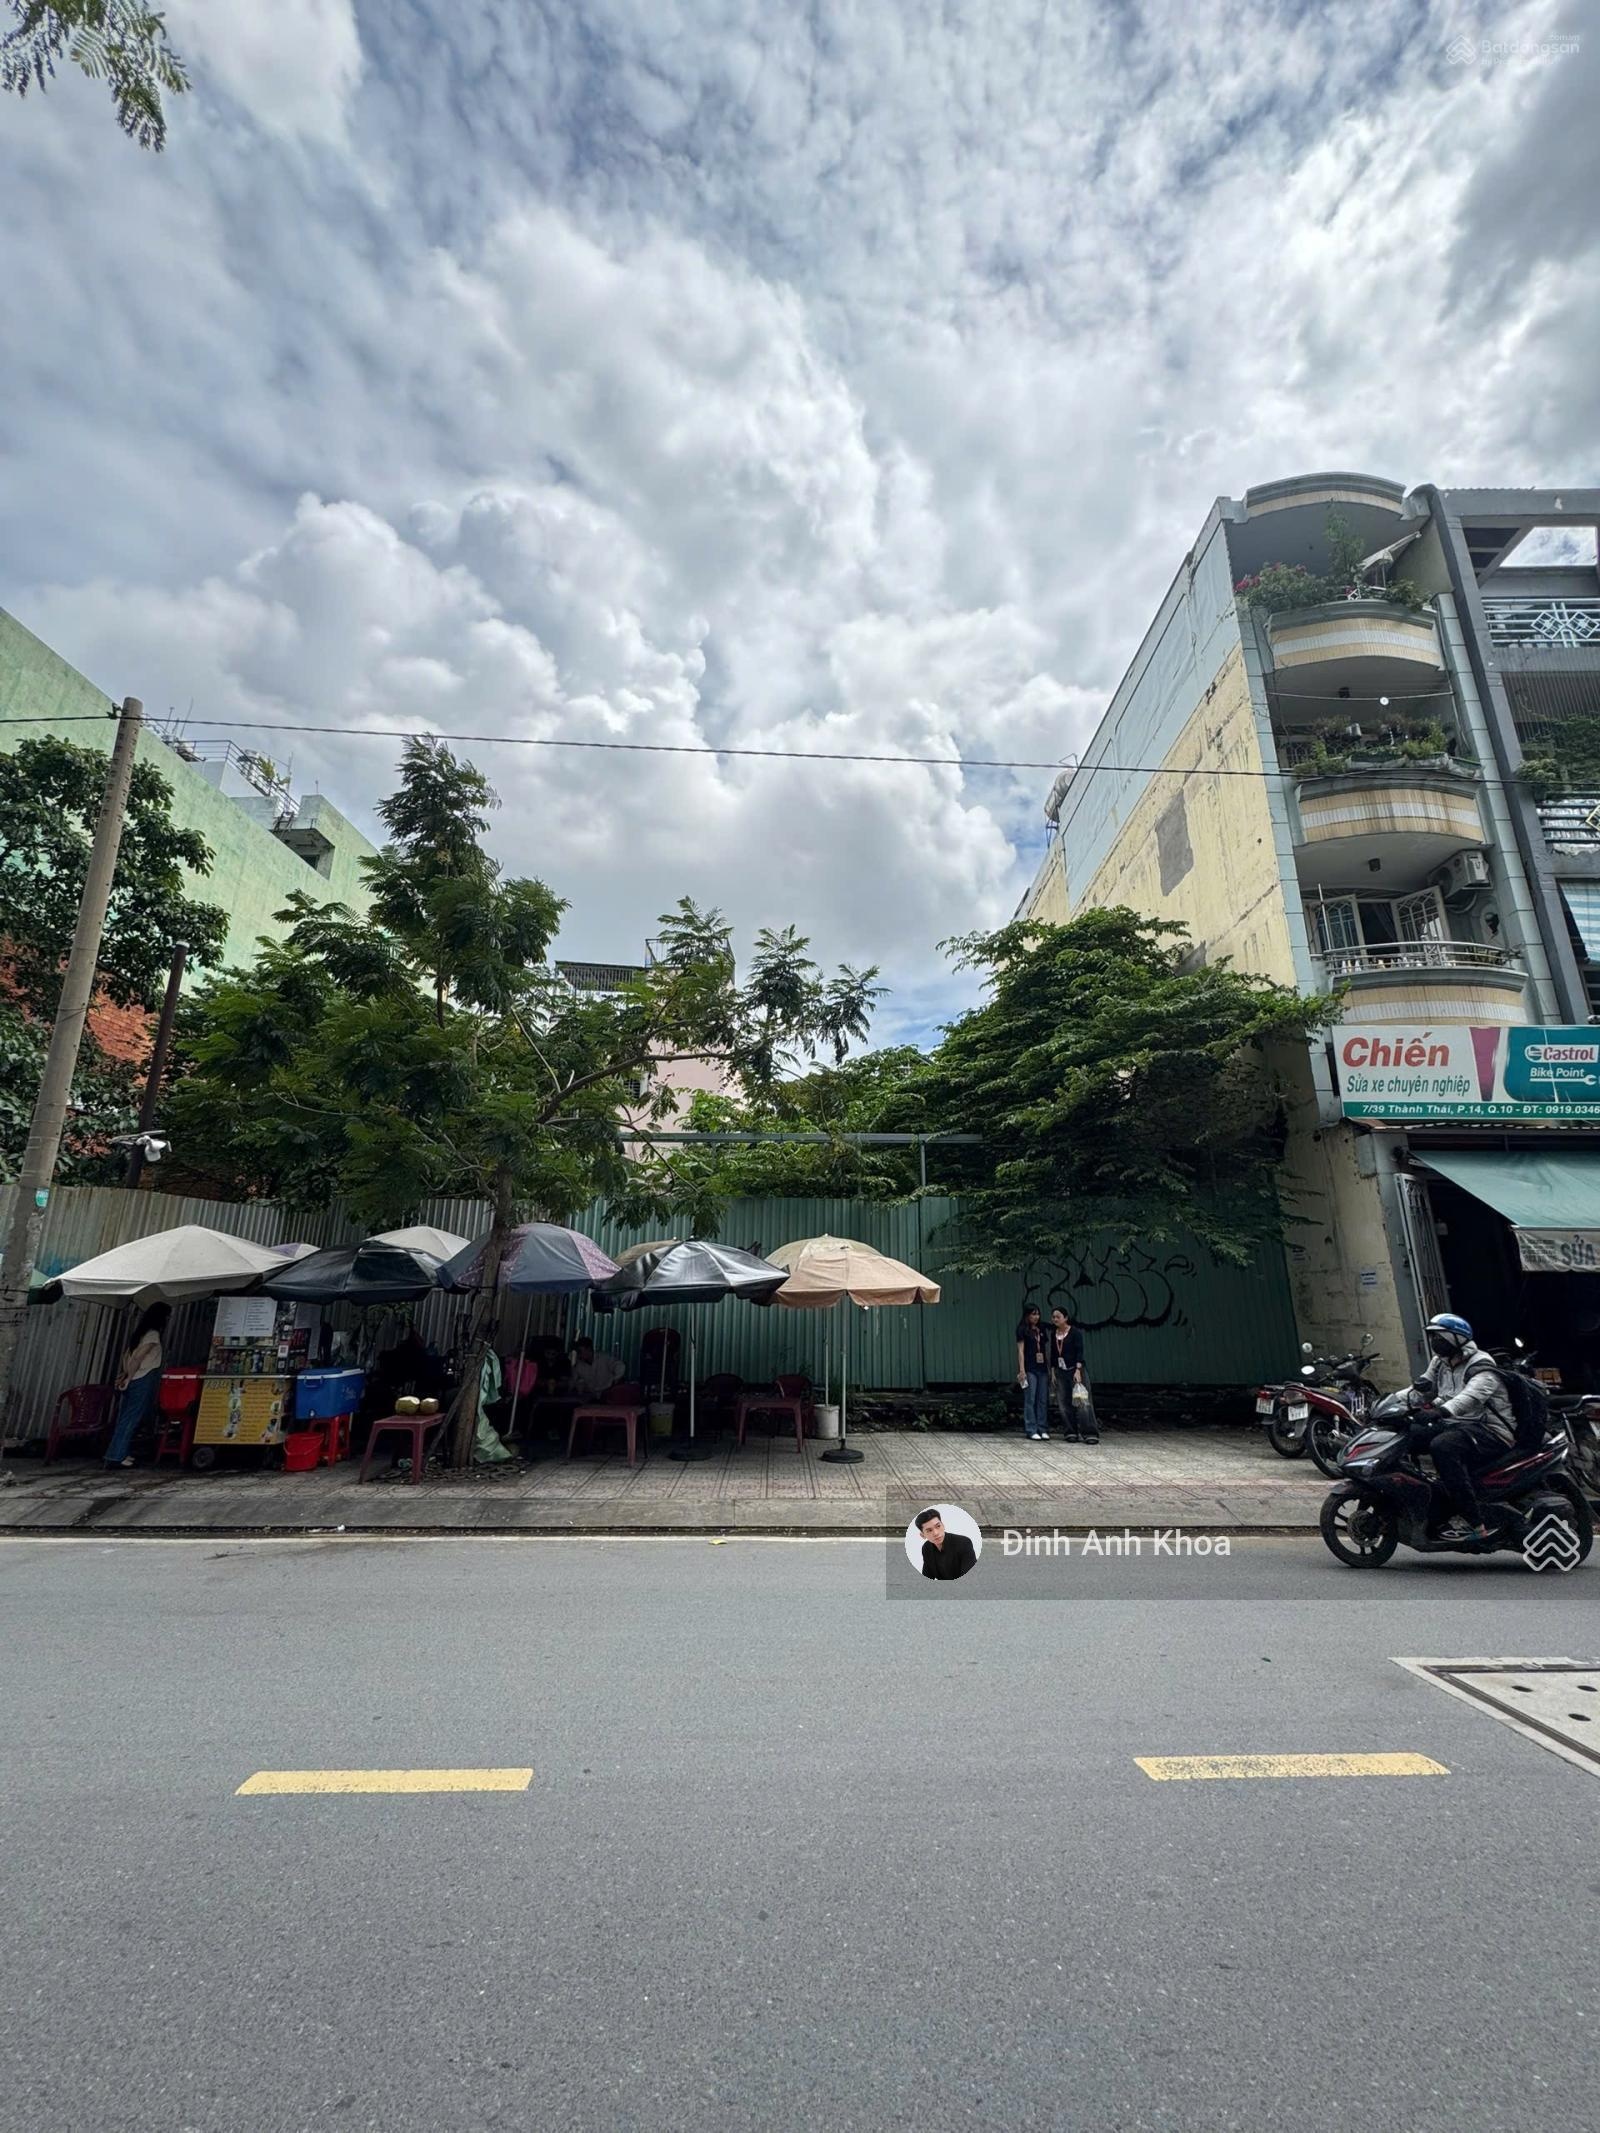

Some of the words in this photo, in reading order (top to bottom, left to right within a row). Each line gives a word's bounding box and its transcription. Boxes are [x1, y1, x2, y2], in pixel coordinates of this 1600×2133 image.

[1342, 1031, 1450, 1068] Chiến
[1543, 1047, 1595, 1061] Castrol
[1530, 1067, 1553, 1077] Bike
[1556, 1067, 1585, 1077] Point
[1347, 1073, 1368, 1093] Sửa
[1371, 1079, 1385, 1093] xe
[1387, 1075, 1429, 1097] chuyên
[1432, 1075, 1471, 1097] nghiệp
[1362, 1104, 1385, 1114] 7/39
[1388, 1104, 1423, 1114] Thành
[1457, 1105, 1485, 1115] P.14,
[1488, 1105, 1514, 1115] Q.10
[1523, 1105, 1544, 1114] ĐT:
[1561, 1234, 1596, 1266] SỬA
